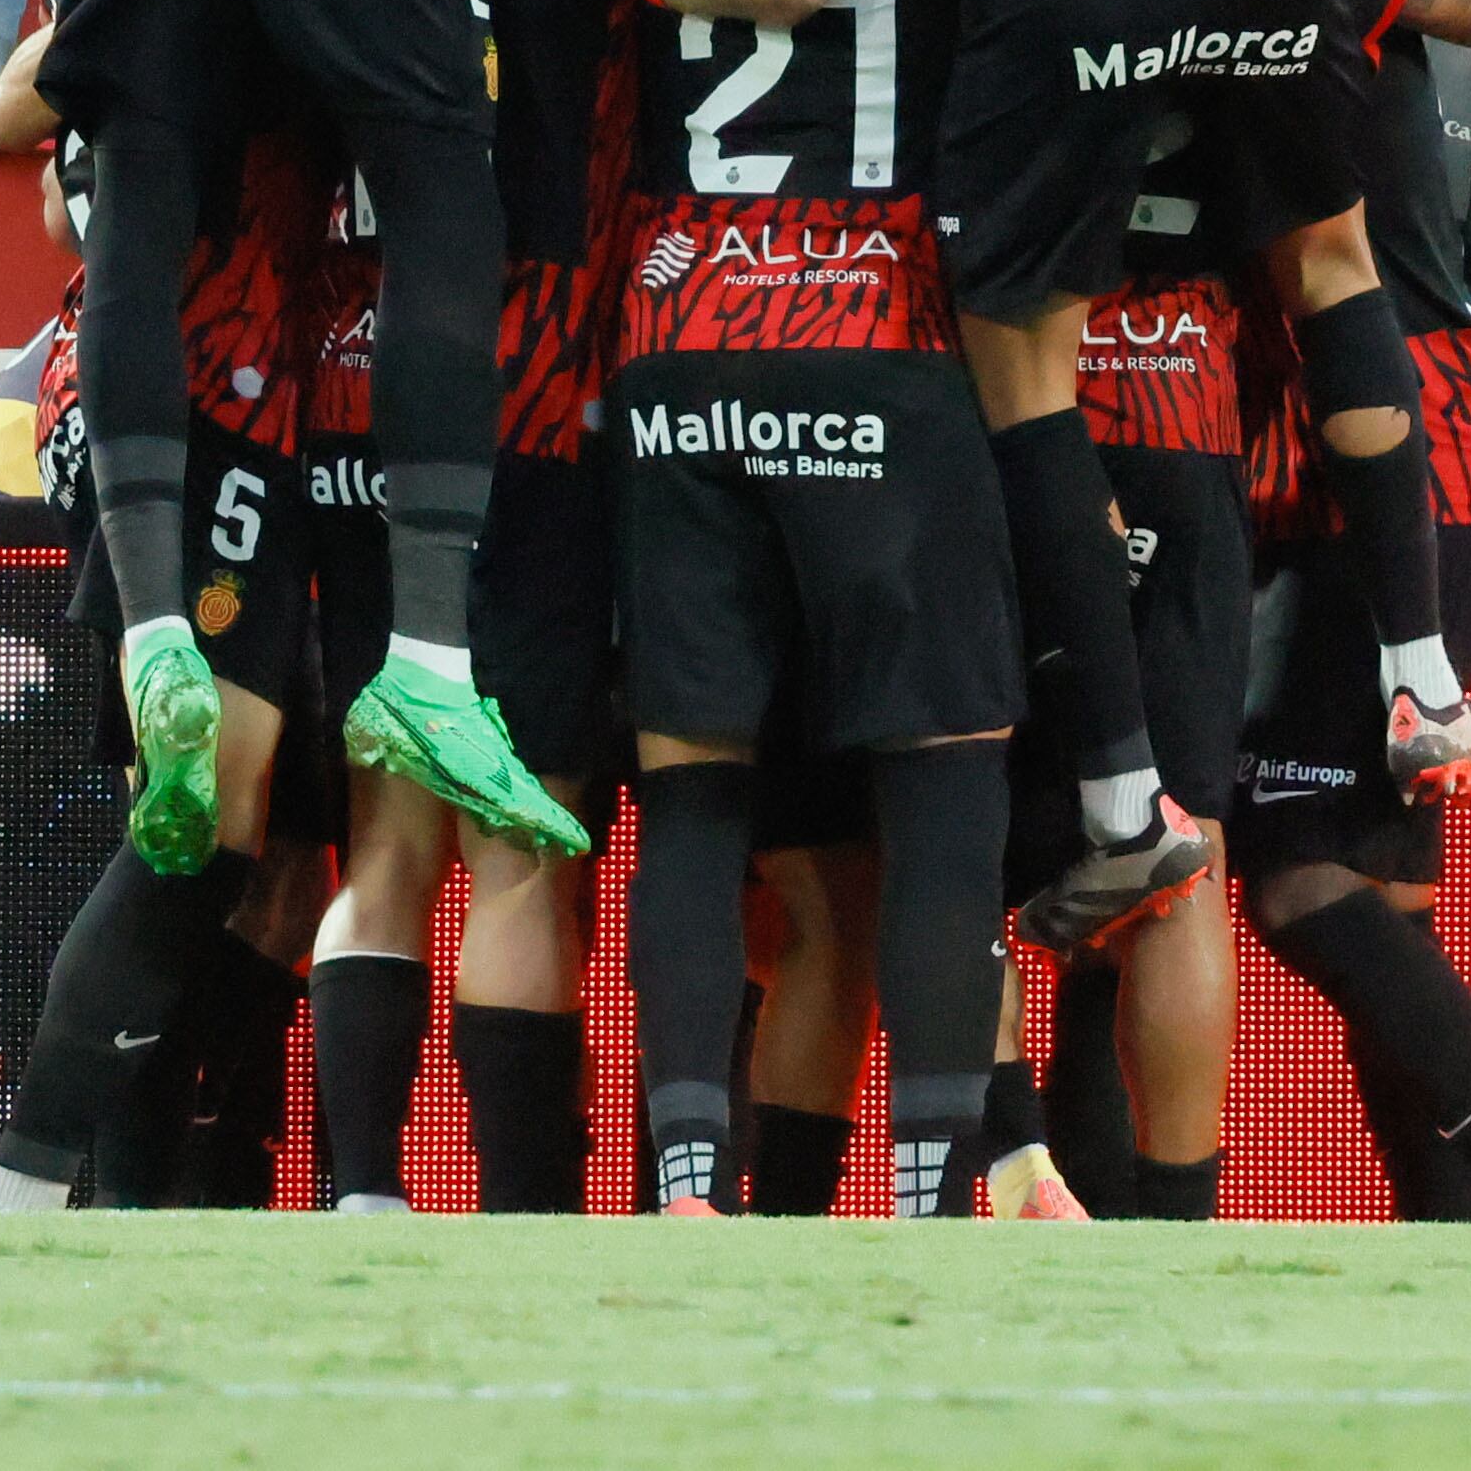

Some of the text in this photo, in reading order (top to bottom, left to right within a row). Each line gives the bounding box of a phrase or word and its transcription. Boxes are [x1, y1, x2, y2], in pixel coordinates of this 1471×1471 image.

[1073, 23, 1319, 92] Mallorca
[1233, 60, 1309, 77] Balears
[707, 224, 899, 267] ALUA
[723, 270, 879, 287] HOTELS & RESORTS
[1082, 310, 1208, 348] LUA
[1078, 356, 1196, 373] ELS & RESORTS
[630, 399, 884, 459] Mallorca
[744, 455, 884, 479] Illes Balears
[211, 467, 266, 562] 5
[1256, 758, 1357, 788] AirEuropa
